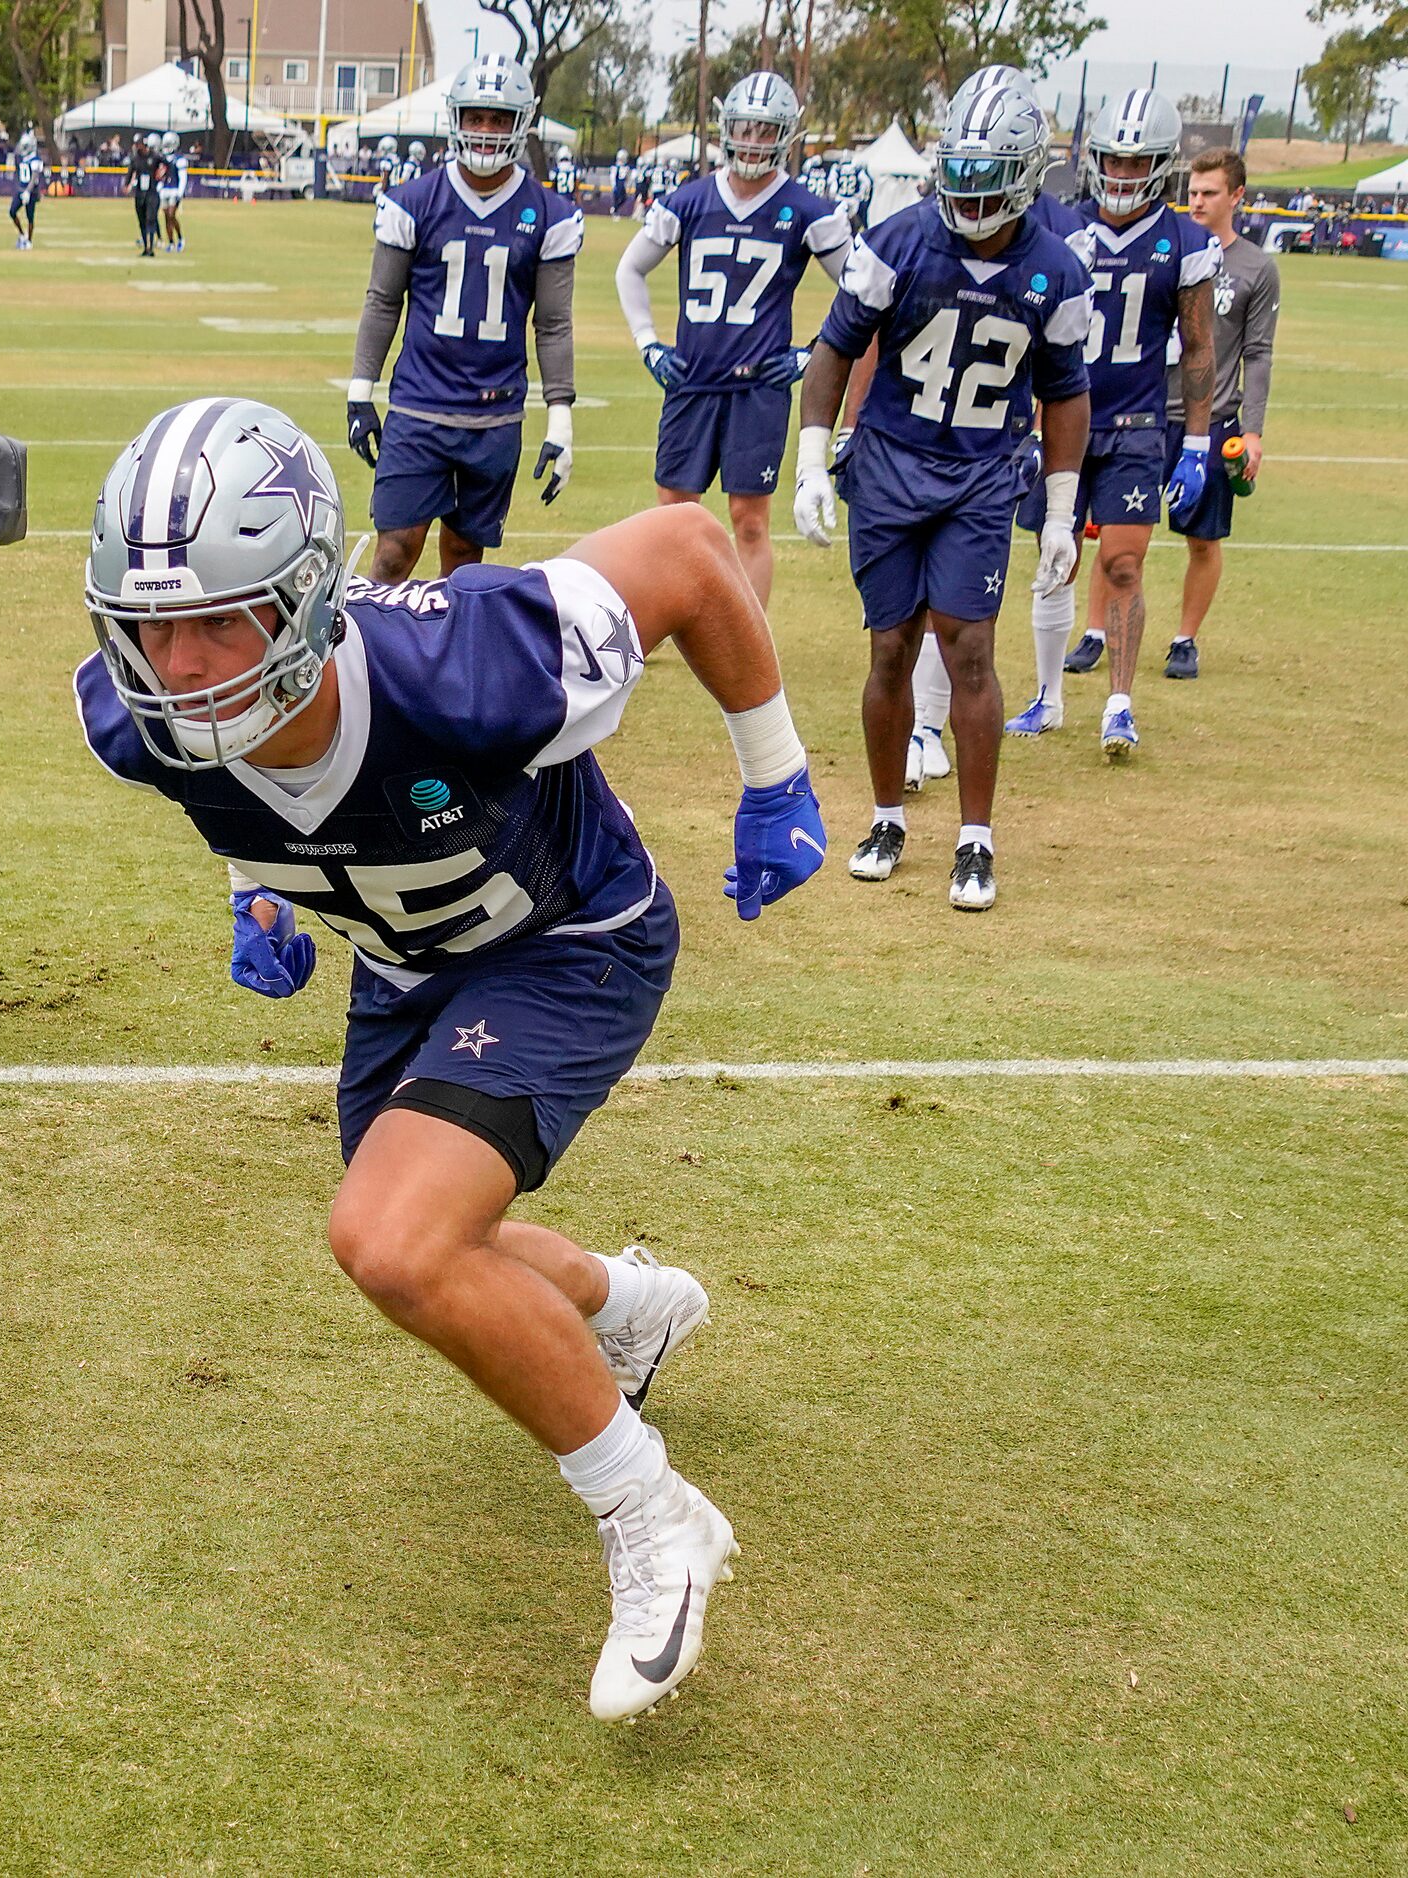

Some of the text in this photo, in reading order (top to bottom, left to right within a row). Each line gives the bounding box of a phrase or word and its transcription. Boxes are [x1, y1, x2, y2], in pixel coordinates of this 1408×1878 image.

[557, 171, 575, 194] 24
[516, 222, 536, 234] AT&T
[1150, 252, 1171, 263] AT&T
[434, 240, 510, 341] 11
[685, 237, 784, 325] 57
[1024, 290, 1046, 306] AT&T
[900, 308, 1032, 429] 42
[134, 579, 183, 591] COWBOYS
[420, 805, 464, 834] AT&T
[284, 842, 358, 856] COWBOYS
